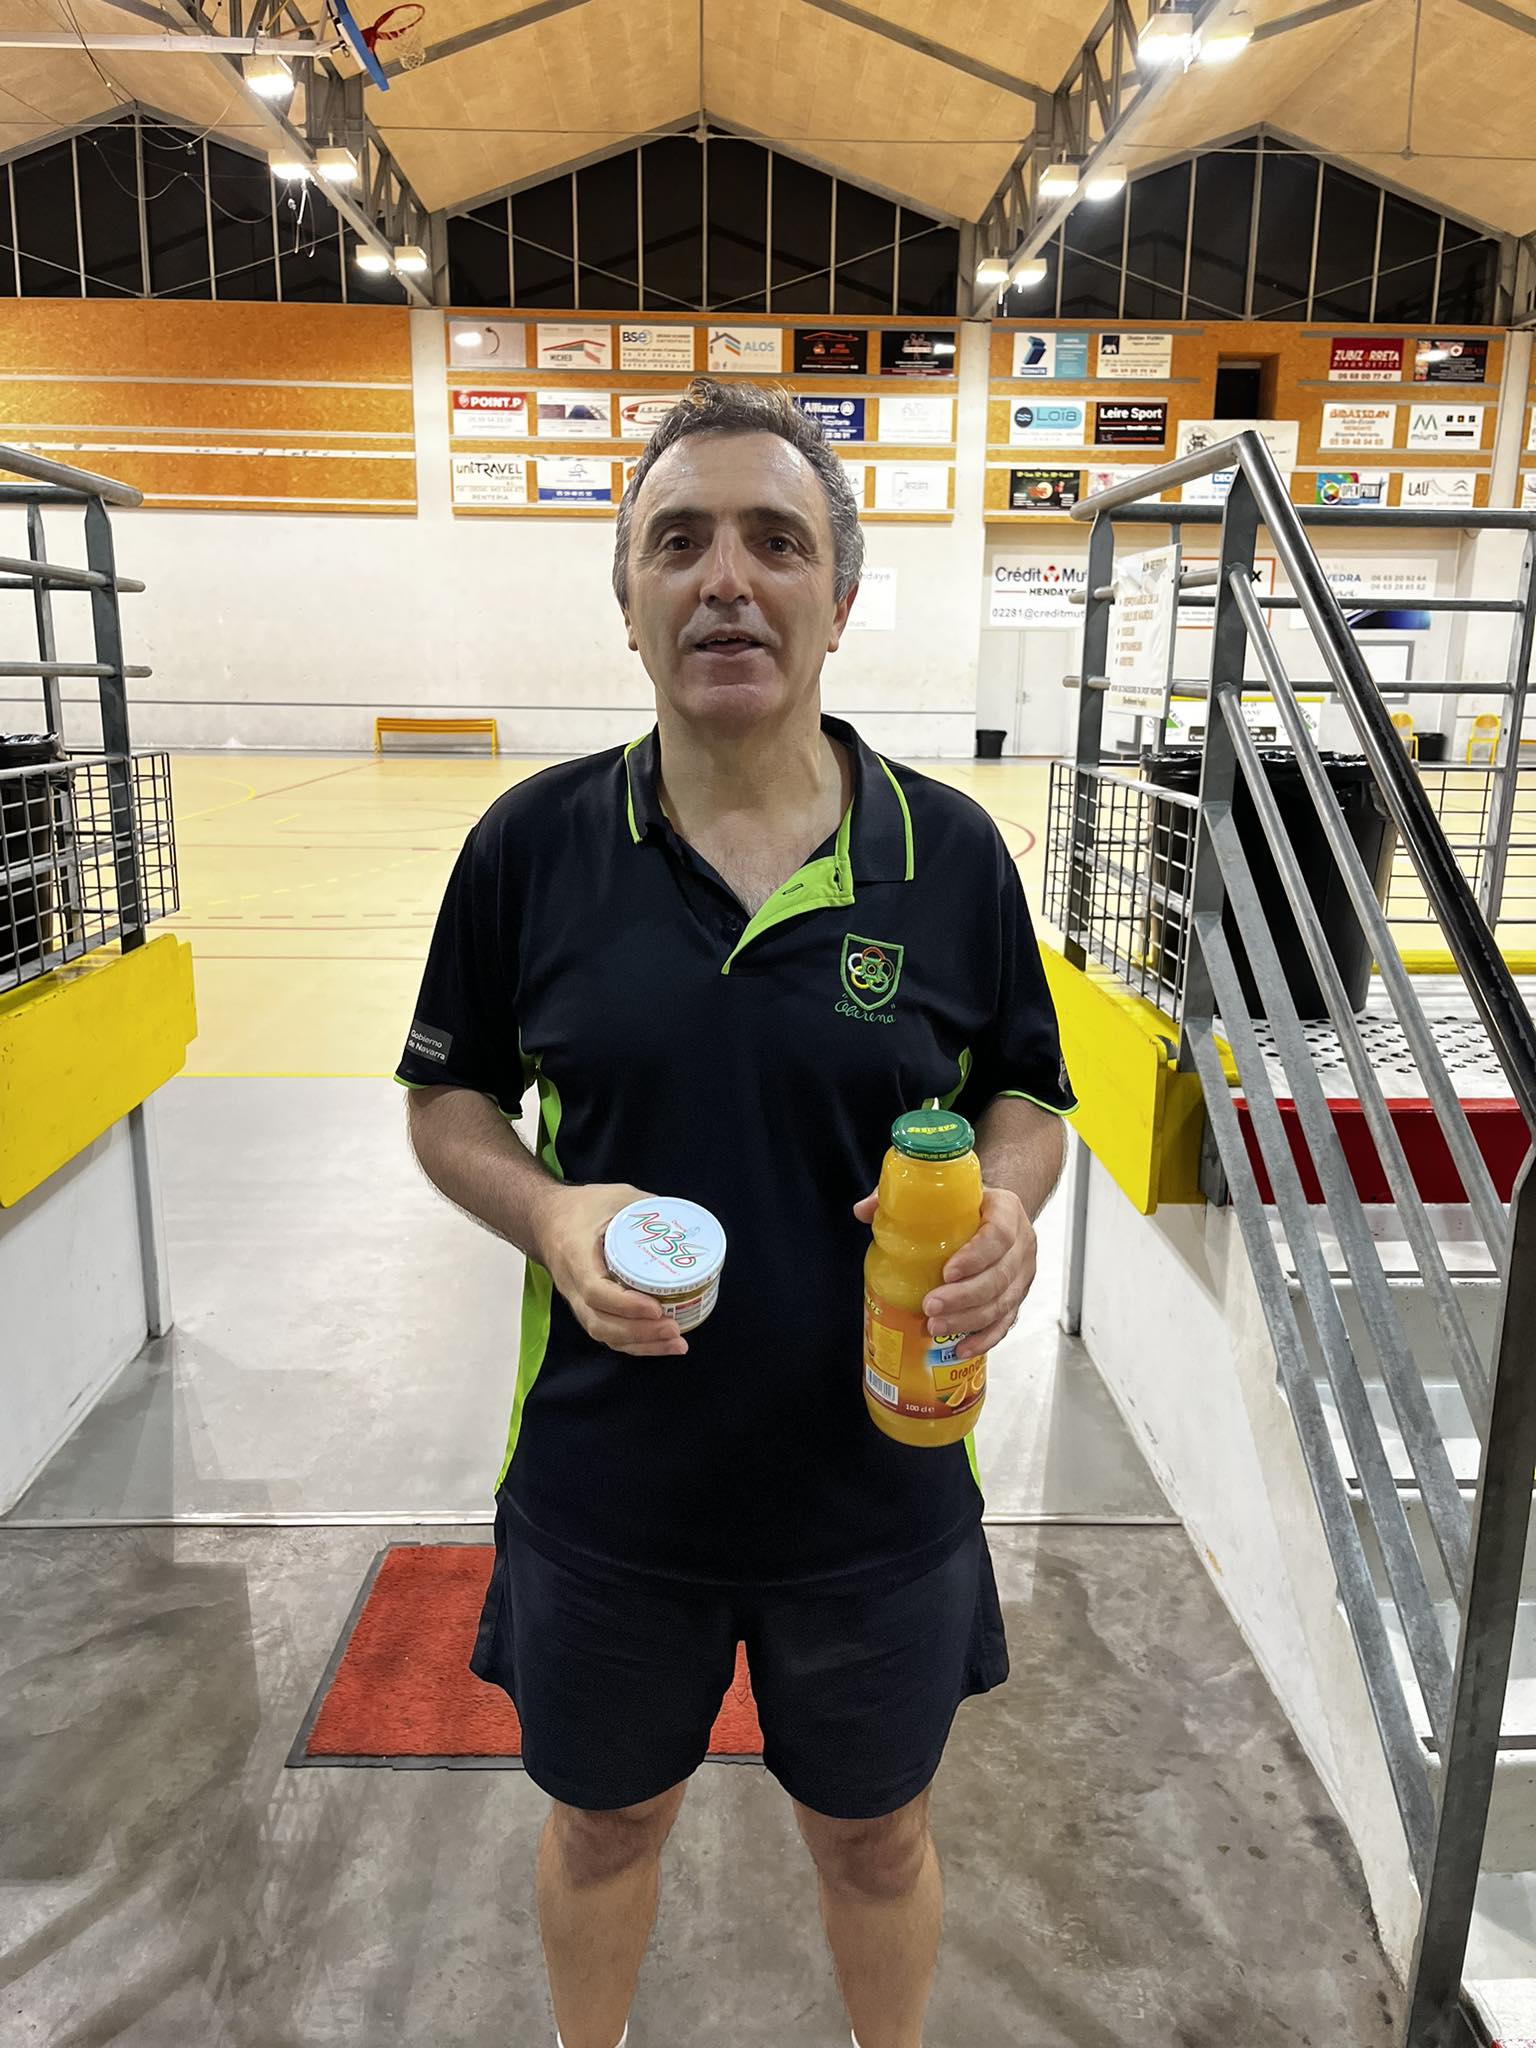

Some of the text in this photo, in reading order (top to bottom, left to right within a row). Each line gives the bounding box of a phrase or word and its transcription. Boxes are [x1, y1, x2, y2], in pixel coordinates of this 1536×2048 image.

[744, 341, 775, 352] ALOS
[1334, 350, 1400, 361] ZUBIZARRETA
[470, 397, 522, 408] POINT.P
[803, 402, 840, 414] Allianz
[1100, 407, 1163, 421] Leire Sport
[995, 566, 1041, 583] Crédit
[411, 1029, 443, 1048] Gobierno
[408, 1039, 445, 1060] de Navarra
[626, 1212, 711, 1268] 1938
[905, 1403, 920, 1413] 100
